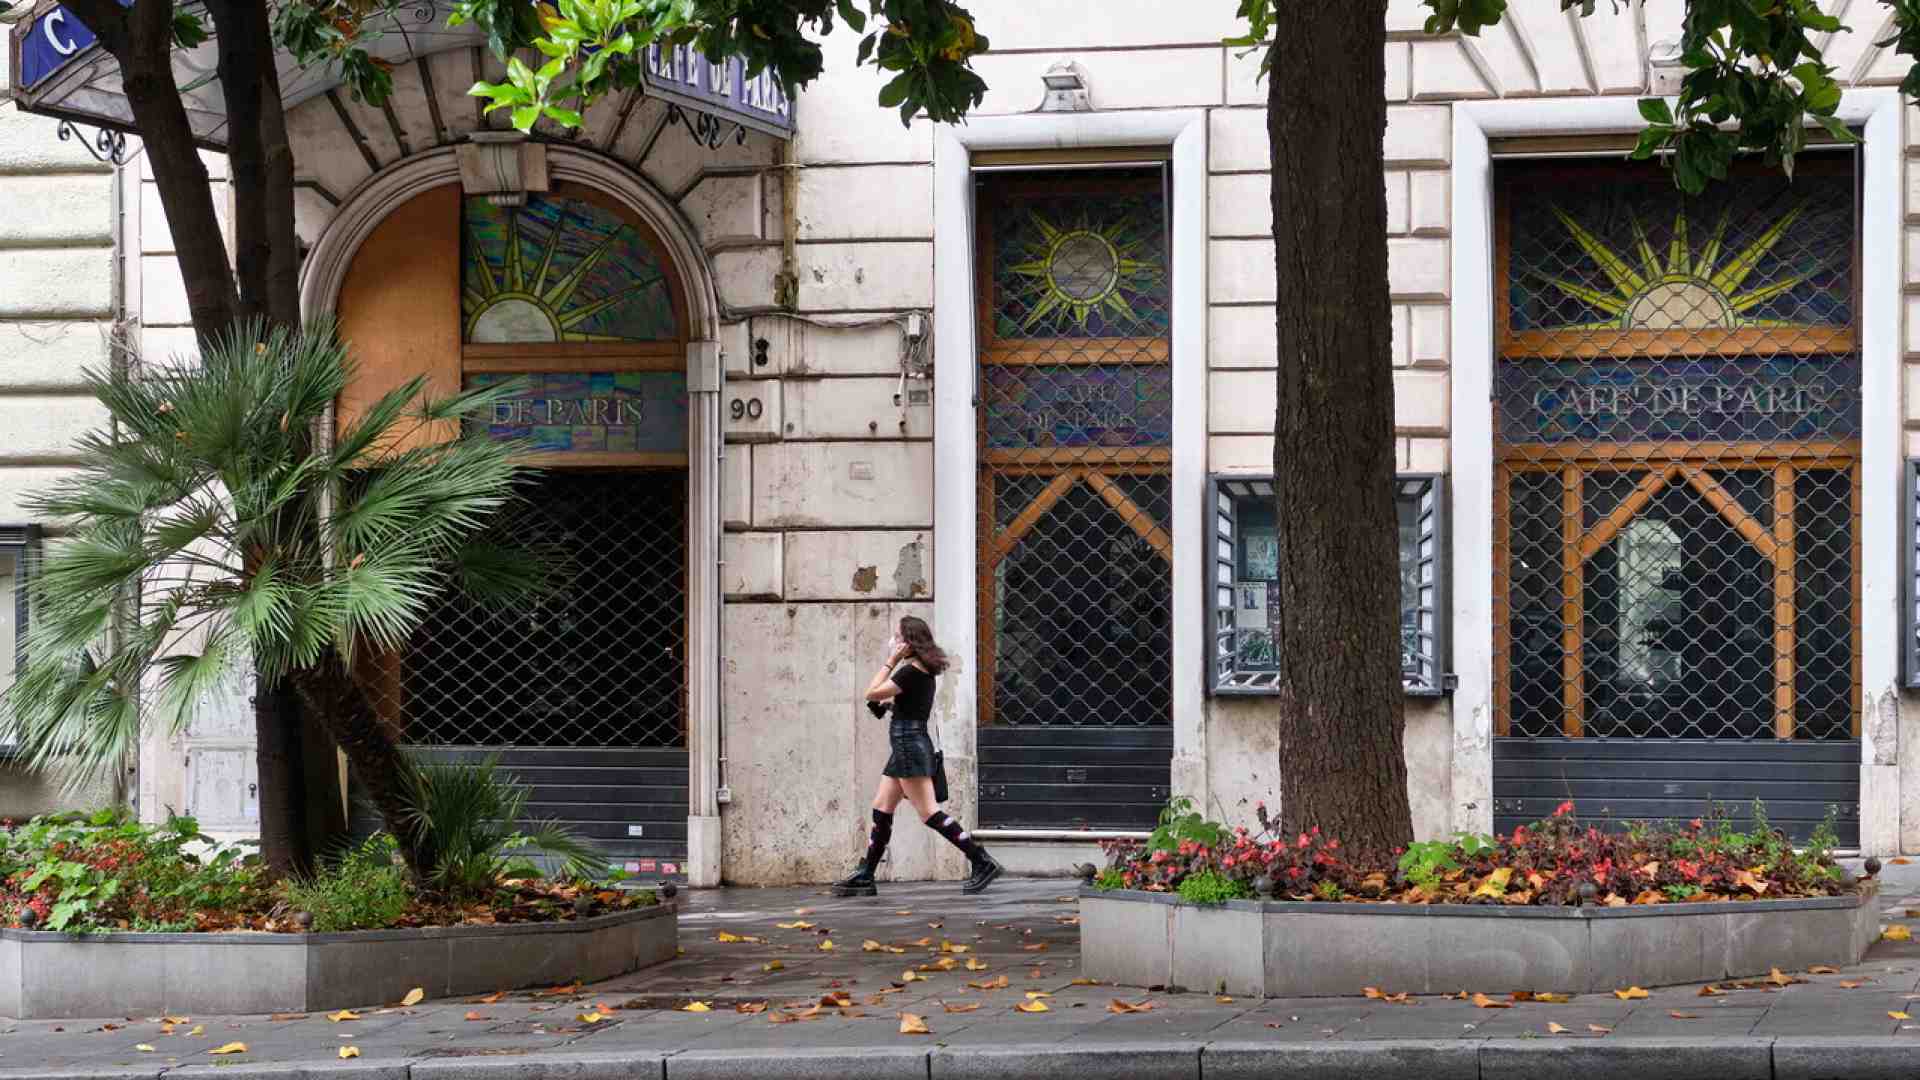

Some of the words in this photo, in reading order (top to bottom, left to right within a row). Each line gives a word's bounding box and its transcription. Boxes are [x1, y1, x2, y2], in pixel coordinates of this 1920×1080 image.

[489, 399, 535, 425] DE
[545, 399, 643, 425] PARIS
[731, 398, 763, 420] 90
[1711, 385, 1826, 413] PARIS
